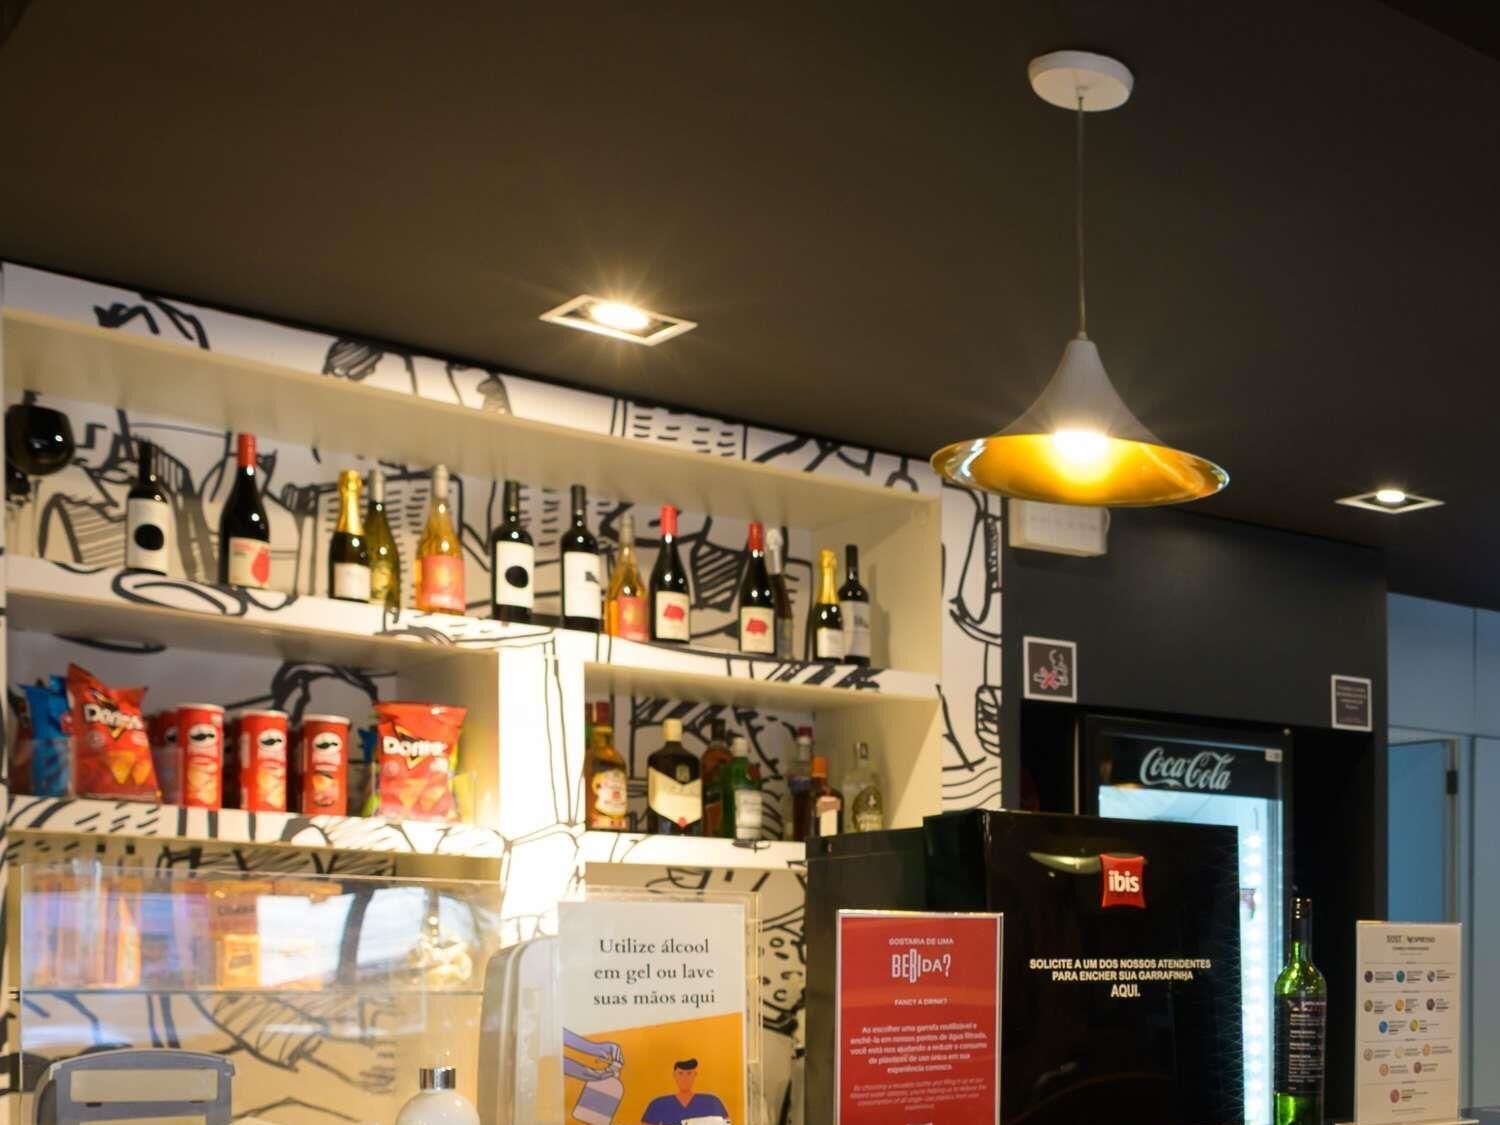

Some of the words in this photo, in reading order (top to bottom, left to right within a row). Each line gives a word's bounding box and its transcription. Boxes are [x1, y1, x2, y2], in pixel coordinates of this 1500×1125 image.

[1108, 870, 1140, 893] ibis
[600, 937, 656, 954] Utilize
[661, 938, 709, 954] álcool
[888, 937, 925, 946] GOSTARIA
[926, 937, 936, 945] DE
[937, 937, 955, 945] UMA
[891, 948, 952, 984] BEBIDA?
[1029, 958, 1074, 970] SOLICITE
[1074, 959, 1082, 969] A
[1082, 959, 1098, 970] UM
[1099, 959, 1119, 969] DOS
[1119, 959, 1156, 970] NOSSOS
[1157, 959, 1212, 970] ATENDENTES
[594, 967, 620, 979] em
[626, 963, 651, 985] gel
[656, 968, 677, 979] ou
[682, 963, 715, 979] lave
[1052, 970, 1079, 981] PARA
[1079, 971, 1117, 981] ENCHER
[1118, 971, 1138, 981] SUA
[1138, 971, 1194, 981] GARRAFINHA
[593, 994, 628, 1006] suas
[633, 990, 676, 1005] mãos
[681, 989, 716, 1008] aqui
[1110, 983, 1141, 998] AQUI.
